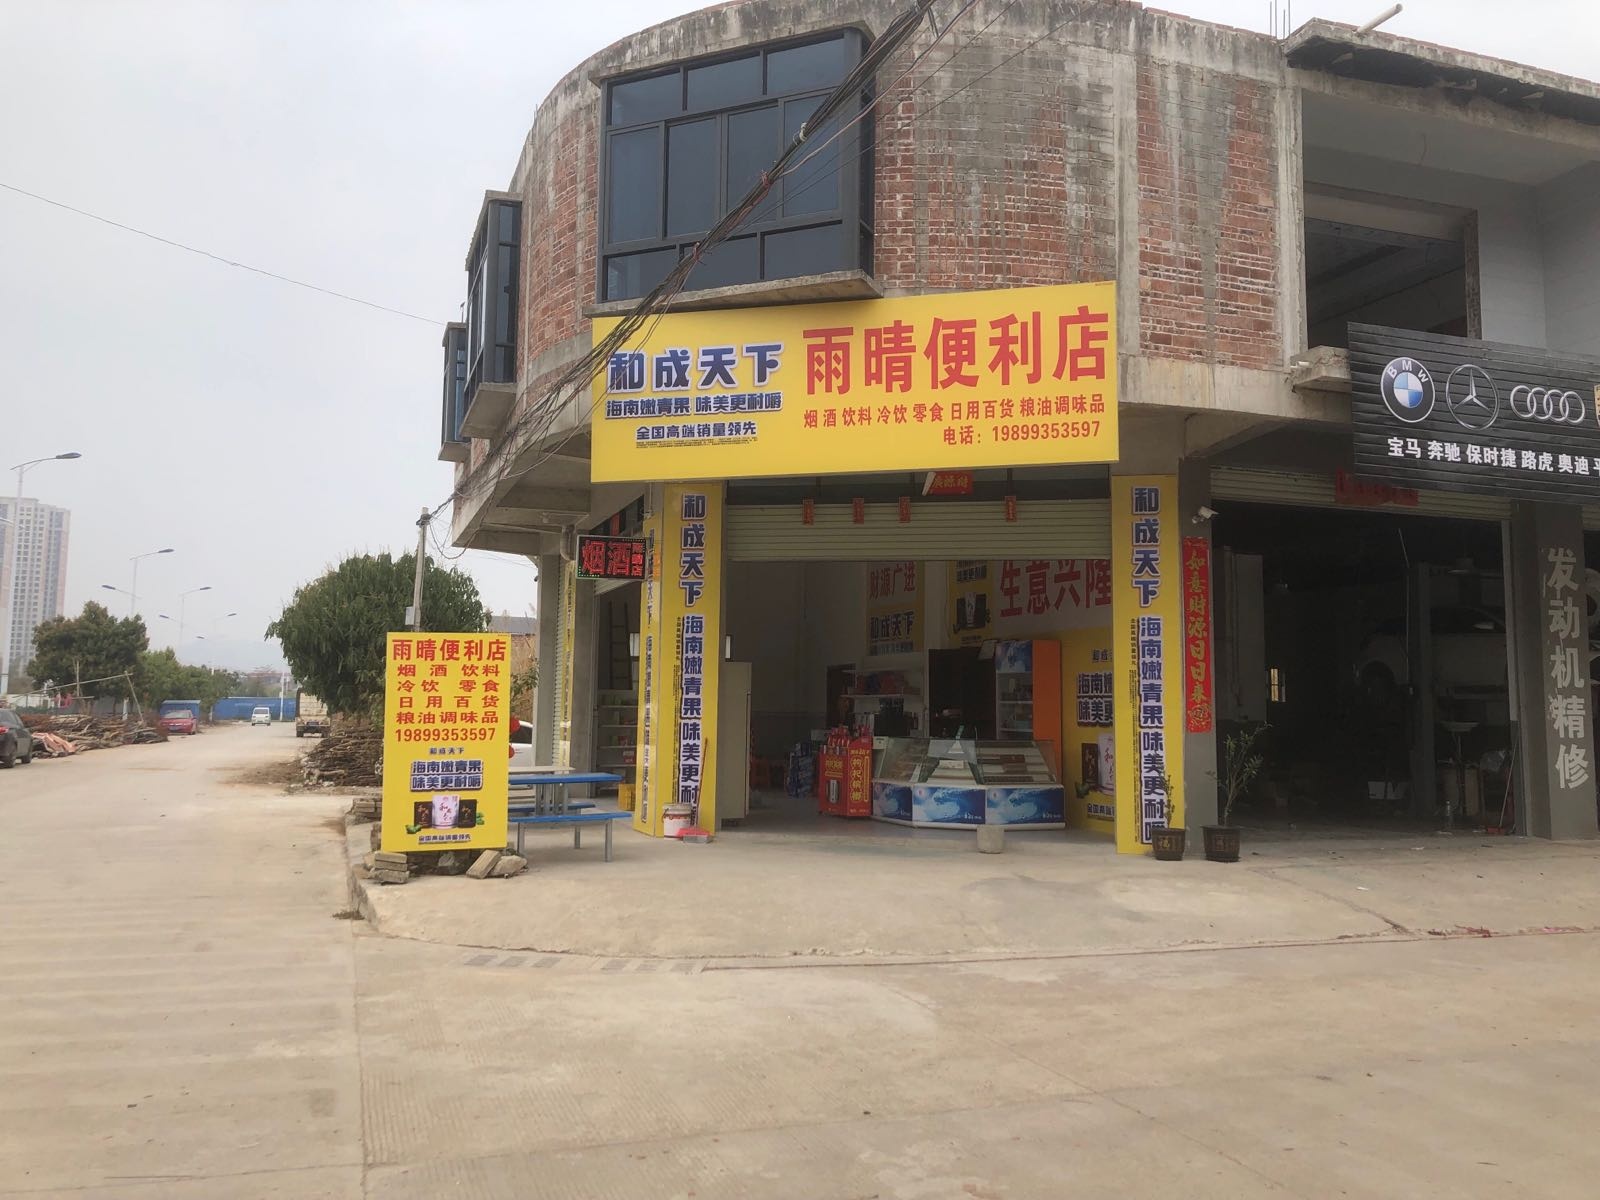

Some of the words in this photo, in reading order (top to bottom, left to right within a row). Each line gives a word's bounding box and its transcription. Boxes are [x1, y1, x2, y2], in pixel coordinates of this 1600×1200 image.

[803, 305, 1109, 395] 雨晴便利店
[609, 343, 783, 391] 和成天下
[1387, 359, 1429, 384] BMW
[606, 395, 691, 417] 海南嫩青果
[695, 391, 782, 414] 味美更耐嚼
[804, 409, 818, 428] 烟
[823, 408, 836, 427] 酒
[842, 405, 872, 426] 饮料
[877, 403, 909, 424] 冷饮
[912, 402, 943, 422] 零食
[951, 398, 1014, 420] 日用百货
[1020, 394, 1105, 417] 粮油调味品
[636, 421, 757, 440] 全国高端销量领先
[992, 420, 1101, 443] 19899353597
[1388, 437, 1421, 458] 宝马
[1428, 441, 1461, 462] 奔驰
[1466, 445, 1516, 468] 保时捷
[1521, 451, 1553, 472] 路虎
[1558, 454, 1590, 475] 奥迪
[583, 540, 632, 576] 烟酒
[682, 494, 706, 606] 和成天下
[1132, 487, 1160, 607] 和成天下
[392, 639, 507, 662] 雨晴便利店
[397, 664, 416, 677] 烟
[430, 664, 447, 677] 酒
[461, 664, 500, 677] 饮料
[683, 615, 703, 718] 海南嫩青果
[1140, 616, 1164, 725] 海南嫩青果
[1546, 547, 1589, 789] 发动机精修
[397, 680, 439, 693] 冷饮
[459, 680, 500, 693] 零食
[399, 695, 500, 709] 日用百货
[396, 711, 499, 725] 粮油调味品
[395, 728, 496, 742] 19899353597
[412, 760, 483, 774] 海南嫩青果
[411, 774, 483, 790] 味美更耐嚼
